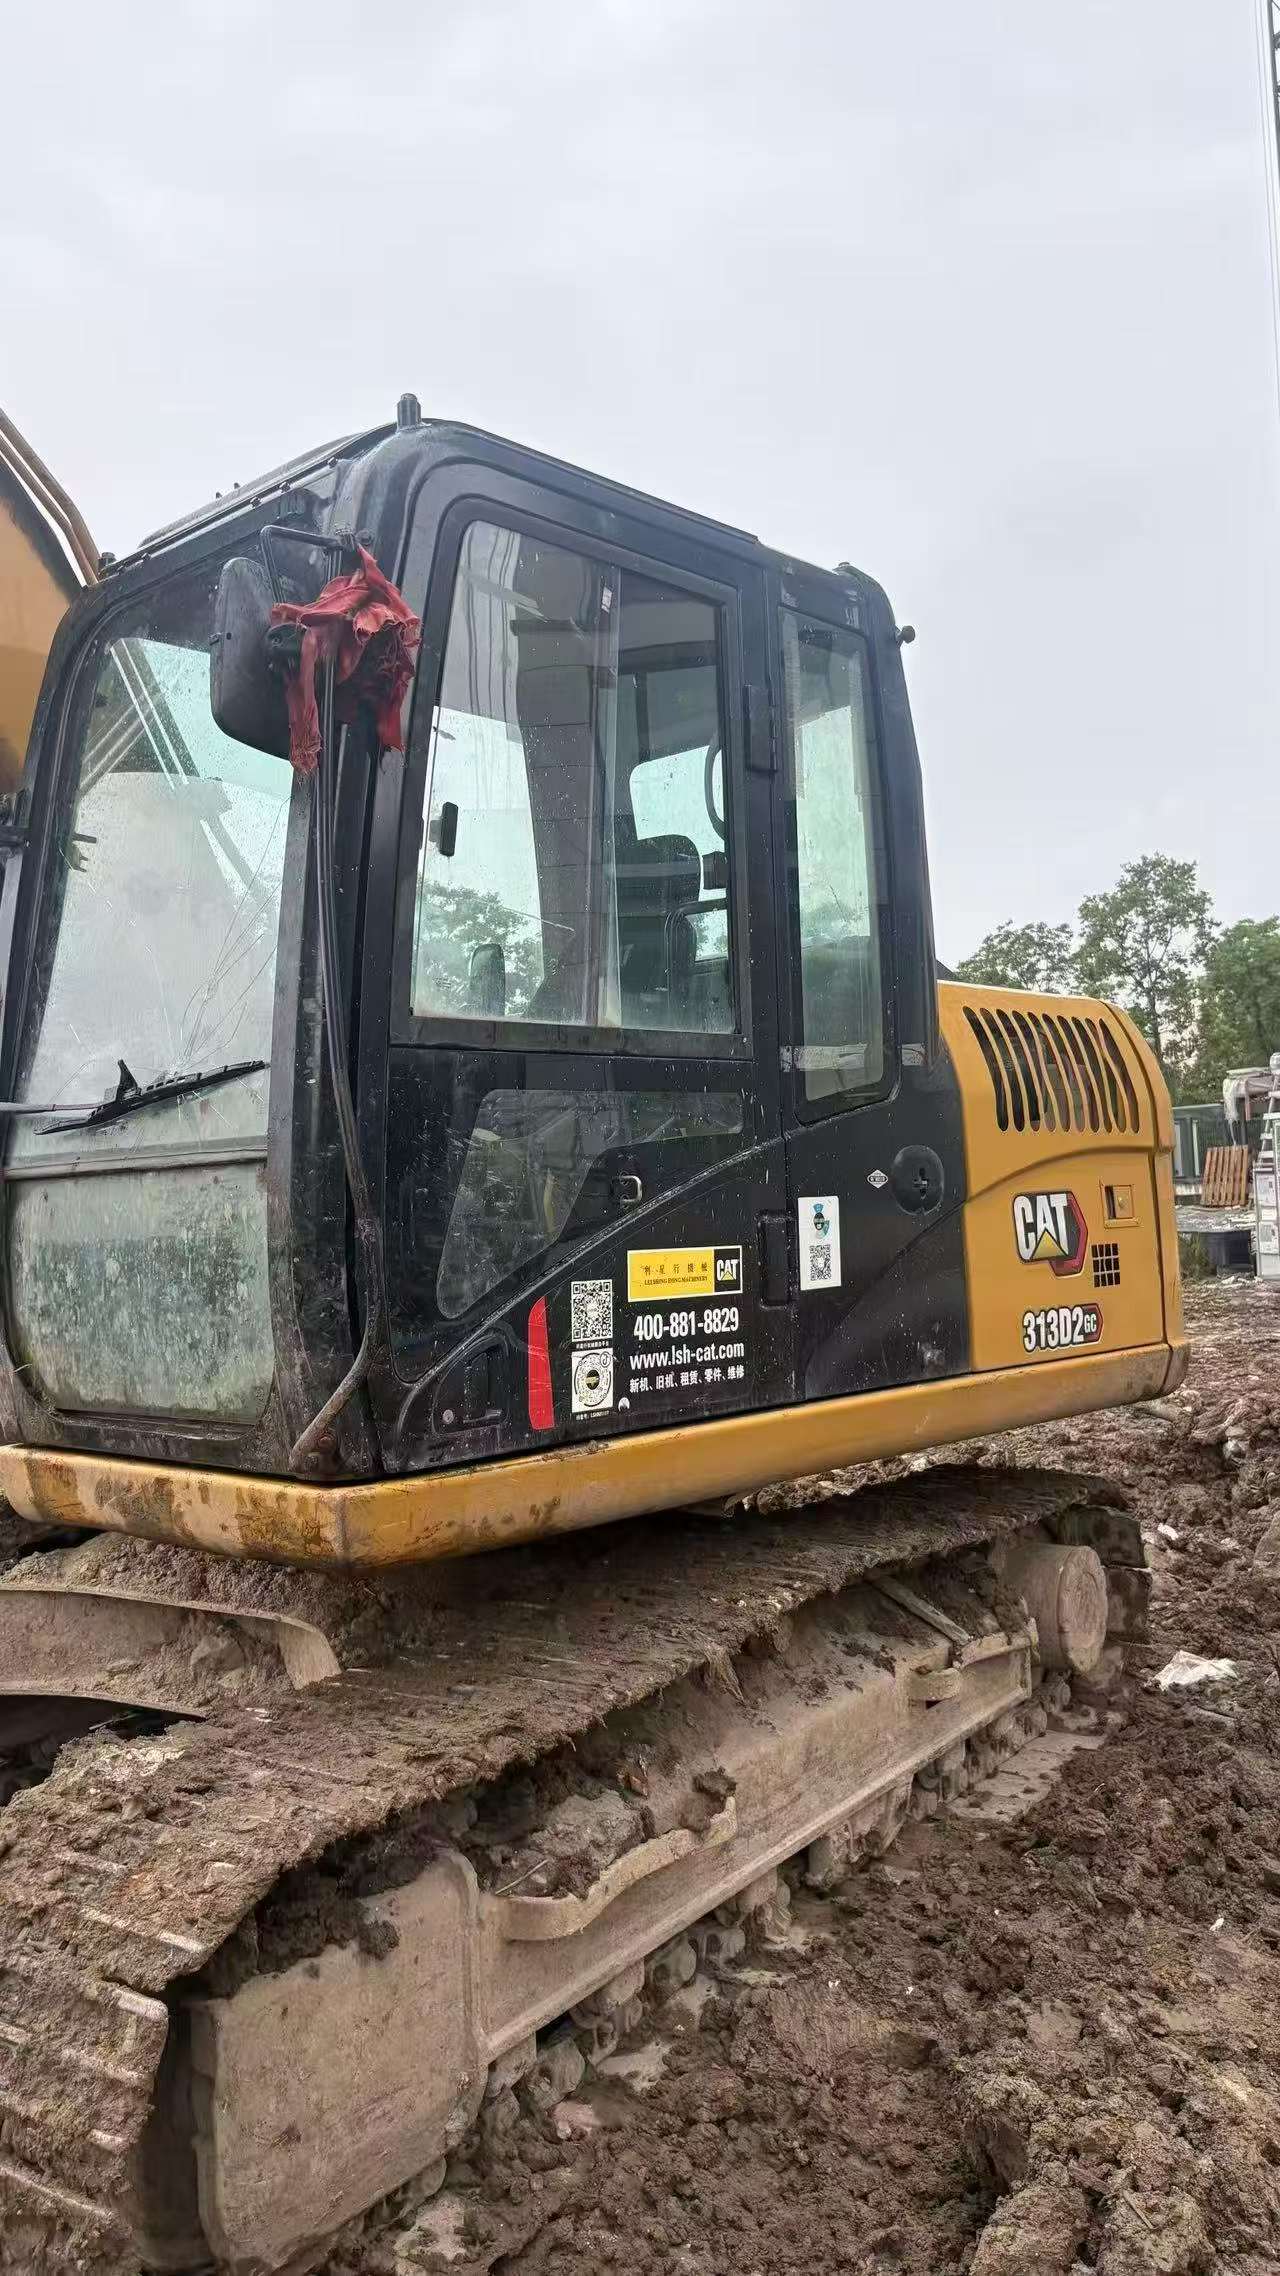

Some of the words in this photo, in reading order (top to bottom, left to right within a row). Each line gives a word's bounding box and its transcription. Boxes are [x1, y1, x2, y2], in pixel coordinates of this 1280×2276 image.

[1013, 1193, 1068, 1261] CAT
[716, 1259, 739, 1281] CAT
[633, 1307, 740, 1341] 400-881-8829
[629, 1342, 745, 1371] www.lsh-cat.com
